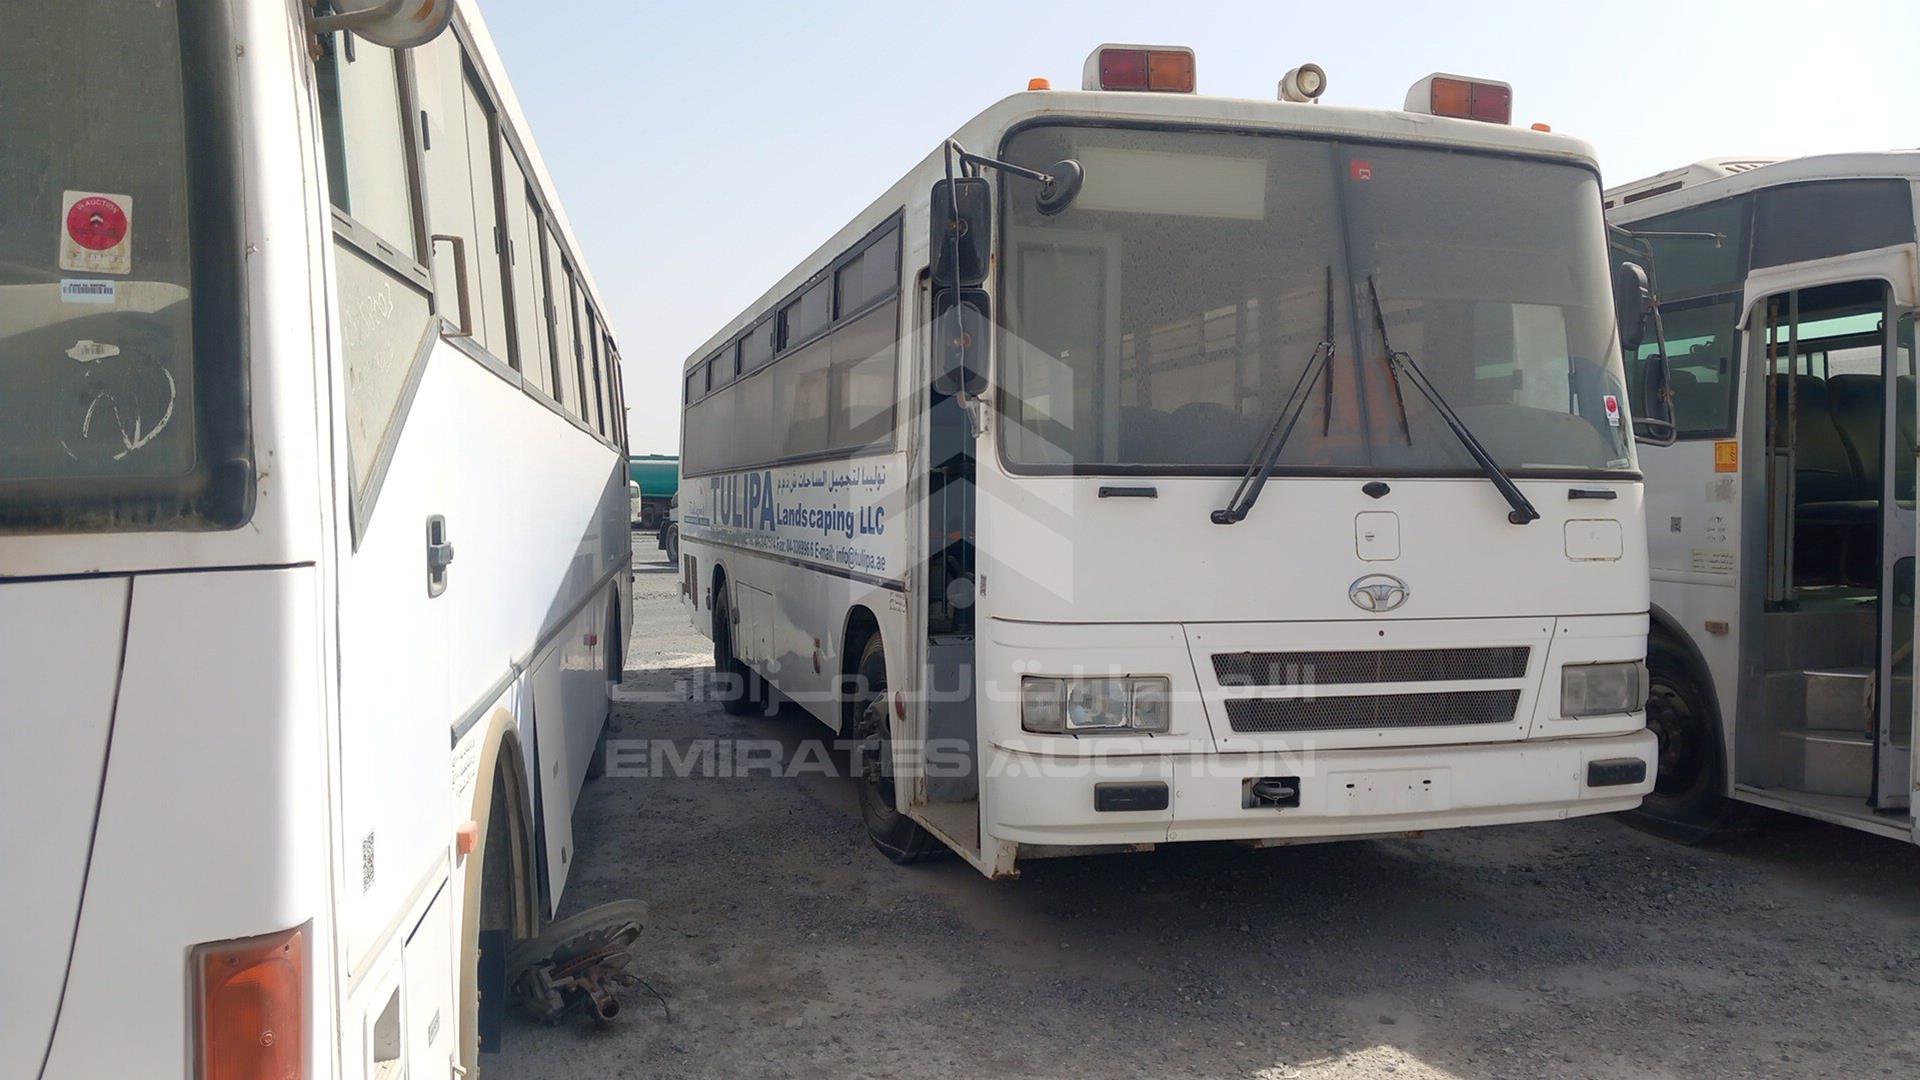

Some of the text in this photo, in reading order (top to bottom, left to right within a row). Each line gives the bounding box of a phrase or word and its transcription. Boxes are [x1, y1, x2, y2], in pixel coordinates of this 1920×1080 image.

[711, 471, 776, 531] TULIPA
[776, 503, 854, 539] Landscaping
[860, 506, 885, 535] LLC
[836, 545, 886, 573] info@tulipa.ae
